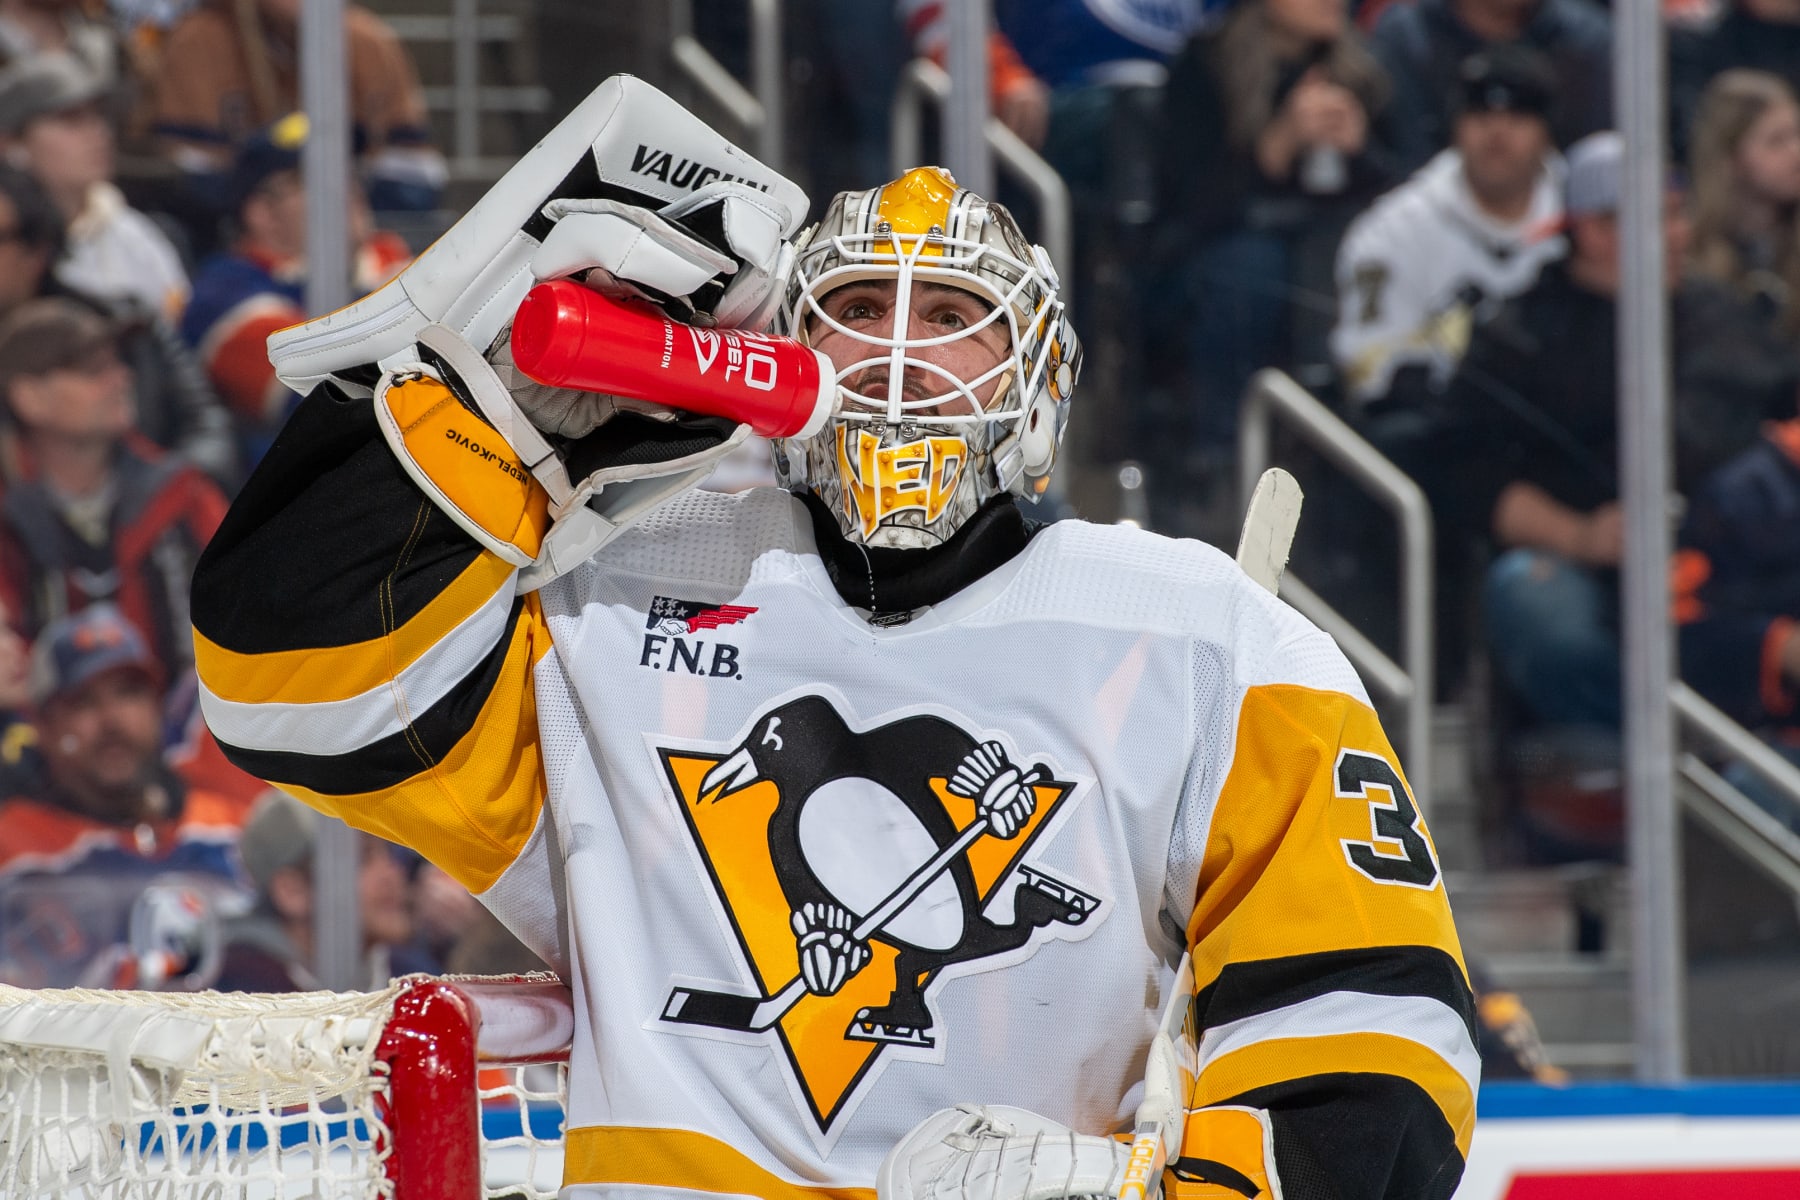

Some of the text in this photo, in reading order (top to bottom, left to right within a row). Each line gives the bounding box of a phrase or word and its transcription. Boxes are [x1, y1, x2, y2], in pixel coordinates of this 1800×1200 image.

[630, 143, 768, 193] VAUG
[724, 332, 743, 383] EEL
[445, 428, 528, 486] NEDELJKOVIC
[835, 420, 969, 543] NED
[639, 633, 743, 681] F.N.B.
